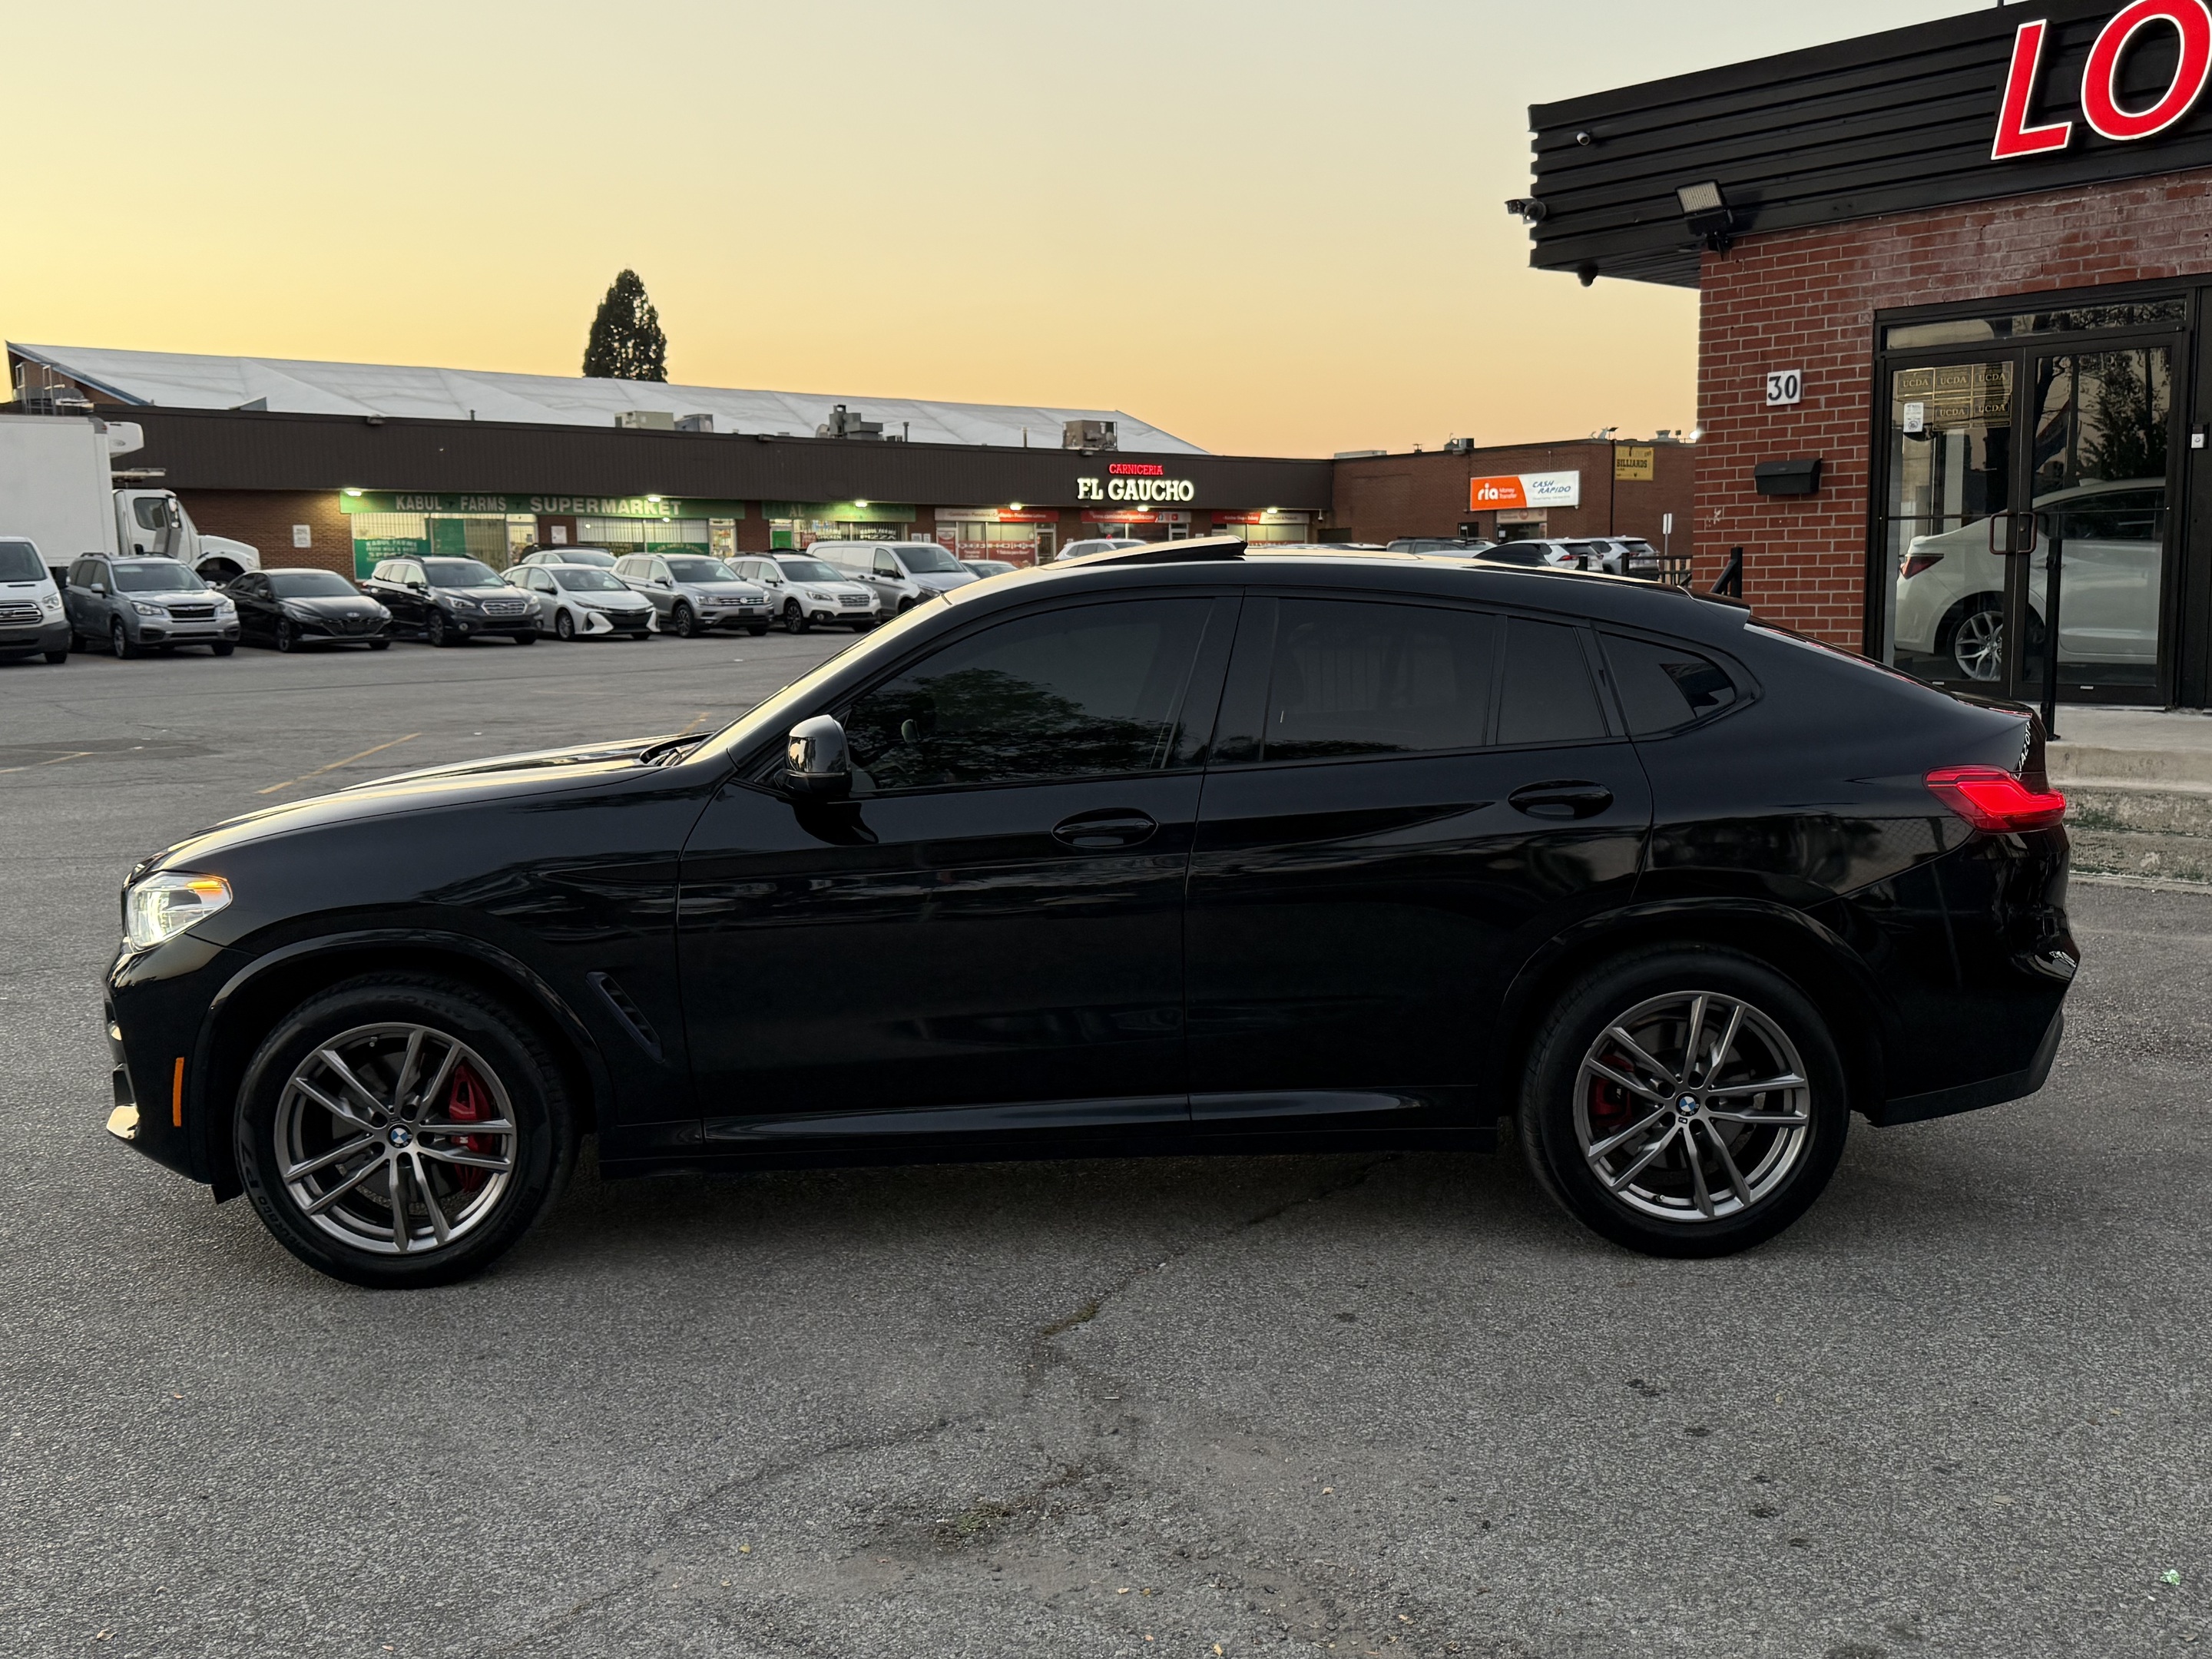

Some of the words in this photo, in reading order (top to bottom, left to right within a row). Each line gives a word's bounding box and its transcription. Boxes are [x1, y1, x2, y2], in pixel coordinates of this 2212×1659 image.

[1940, 376, 1967, 385] UCDA
[1979, 373, 2007, 382] UCDA
[1767, 374, 1799, 401] 30
[1903, 378, 1929, 388] UCDA
[1939, 408, 1965, 416] UCDA
[1979, 404, 2006, 412] UCDA
[1109, 464, 1164, 475] CARNICERIA
[1532, 480, 1555, 488] CASH
[1108, 478, 1194, 502] GAUCHO
[1477, 482, 1499, 501] ria
[1538, 485, 1571, 495] RAPIDO
[396, 495, 442, 511] KABUL
[461, 496, 507, 512] FARMS
[530, 497, 681, 516] SUPERMARKET
